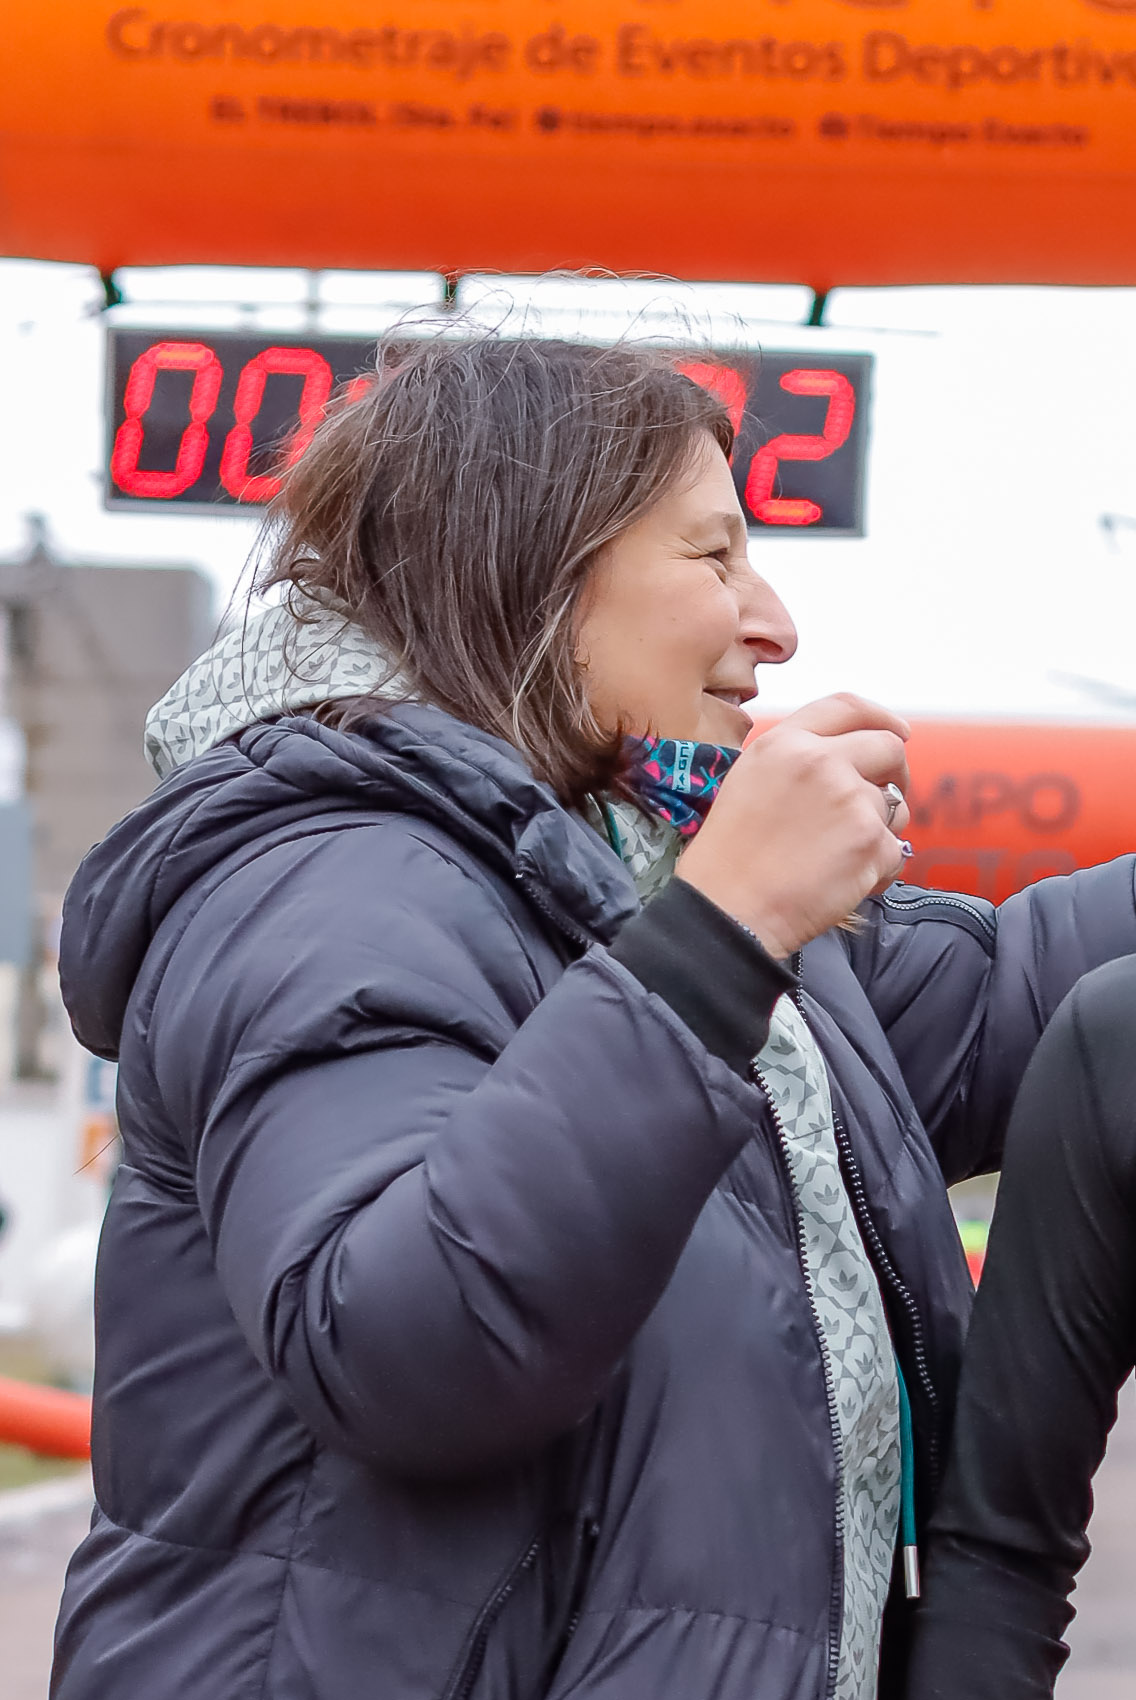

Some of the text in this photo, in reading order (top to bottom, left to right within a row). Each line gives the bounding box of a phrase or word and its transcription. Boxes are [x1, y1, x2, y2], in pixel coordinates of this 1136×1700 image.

[105, 6, 512, 82] Cronometraje
[525, 22, 598, 75] de
[616, 22, 848, 83] Eventos
